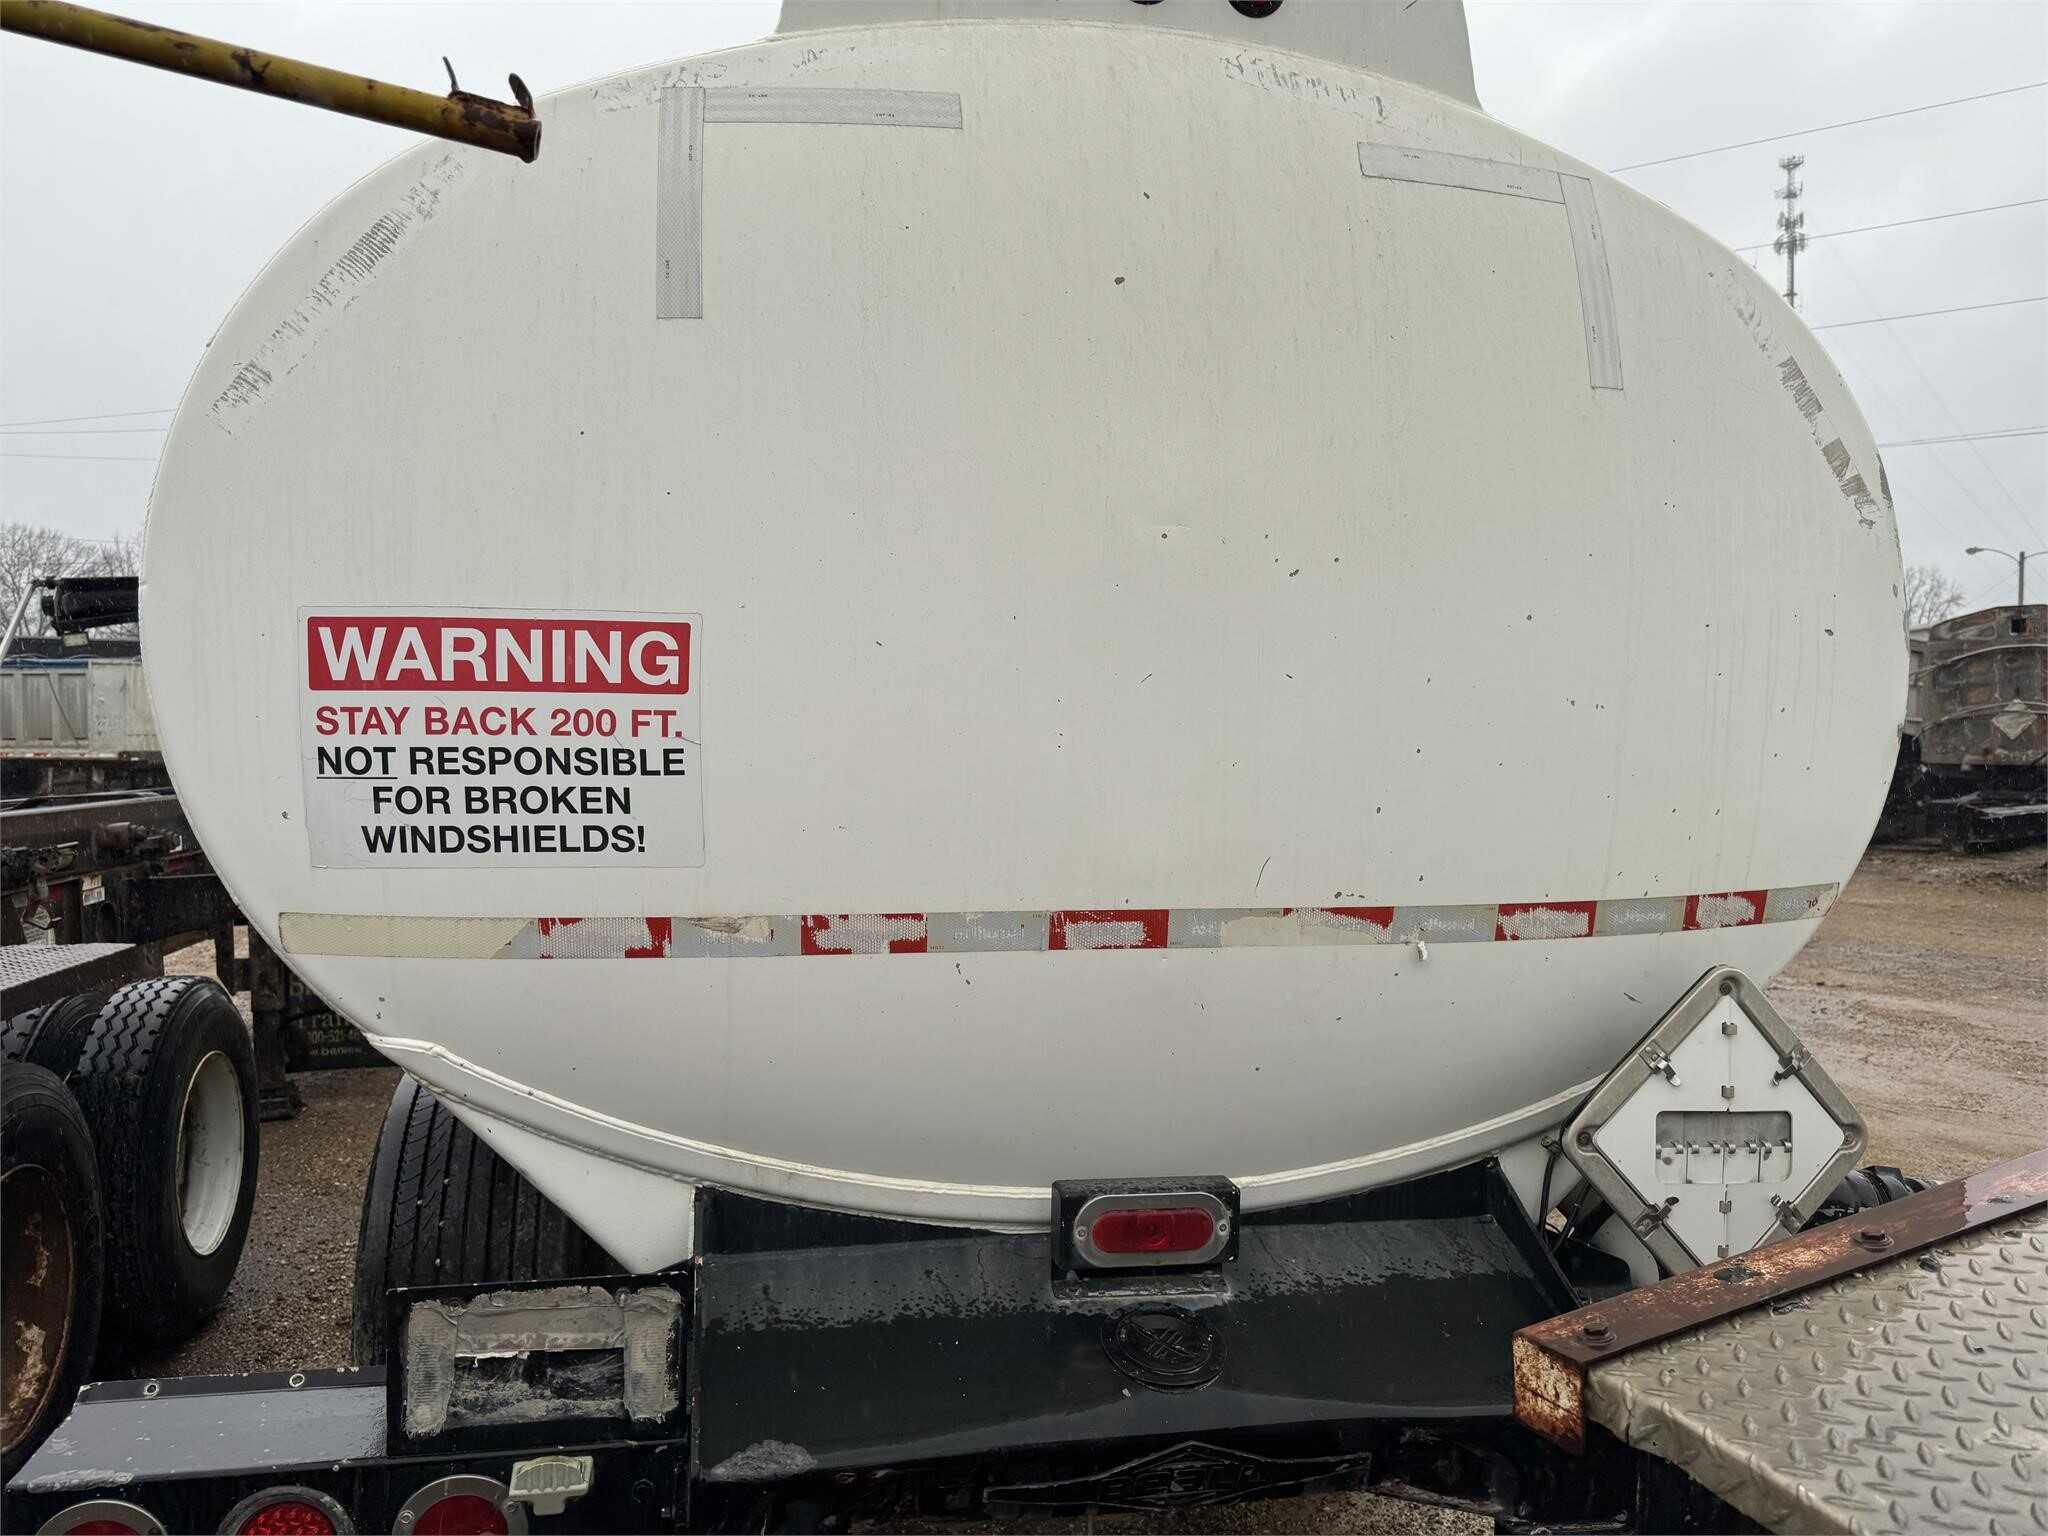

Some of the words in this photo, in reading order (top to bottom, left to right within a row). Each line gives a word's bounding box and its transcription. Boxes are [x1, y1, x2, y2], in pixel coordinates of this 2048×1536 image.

[318, 625, 681, 687] WARNING
[315, 705, 410, 736] STAY
[424, 706, 537, 736] BACK
[550, 708, 618, 737] 200
[631, 709, 684, 738] FT.
[316, 746, 398, 776] NOT
[409, 746, 686, 776] RESPONSIBLE
[372, 786, 451, 814] FOR
[464, 786, 631, 815] BROKEN
[361, 825, 646, 853] WINDSHIELDS!
